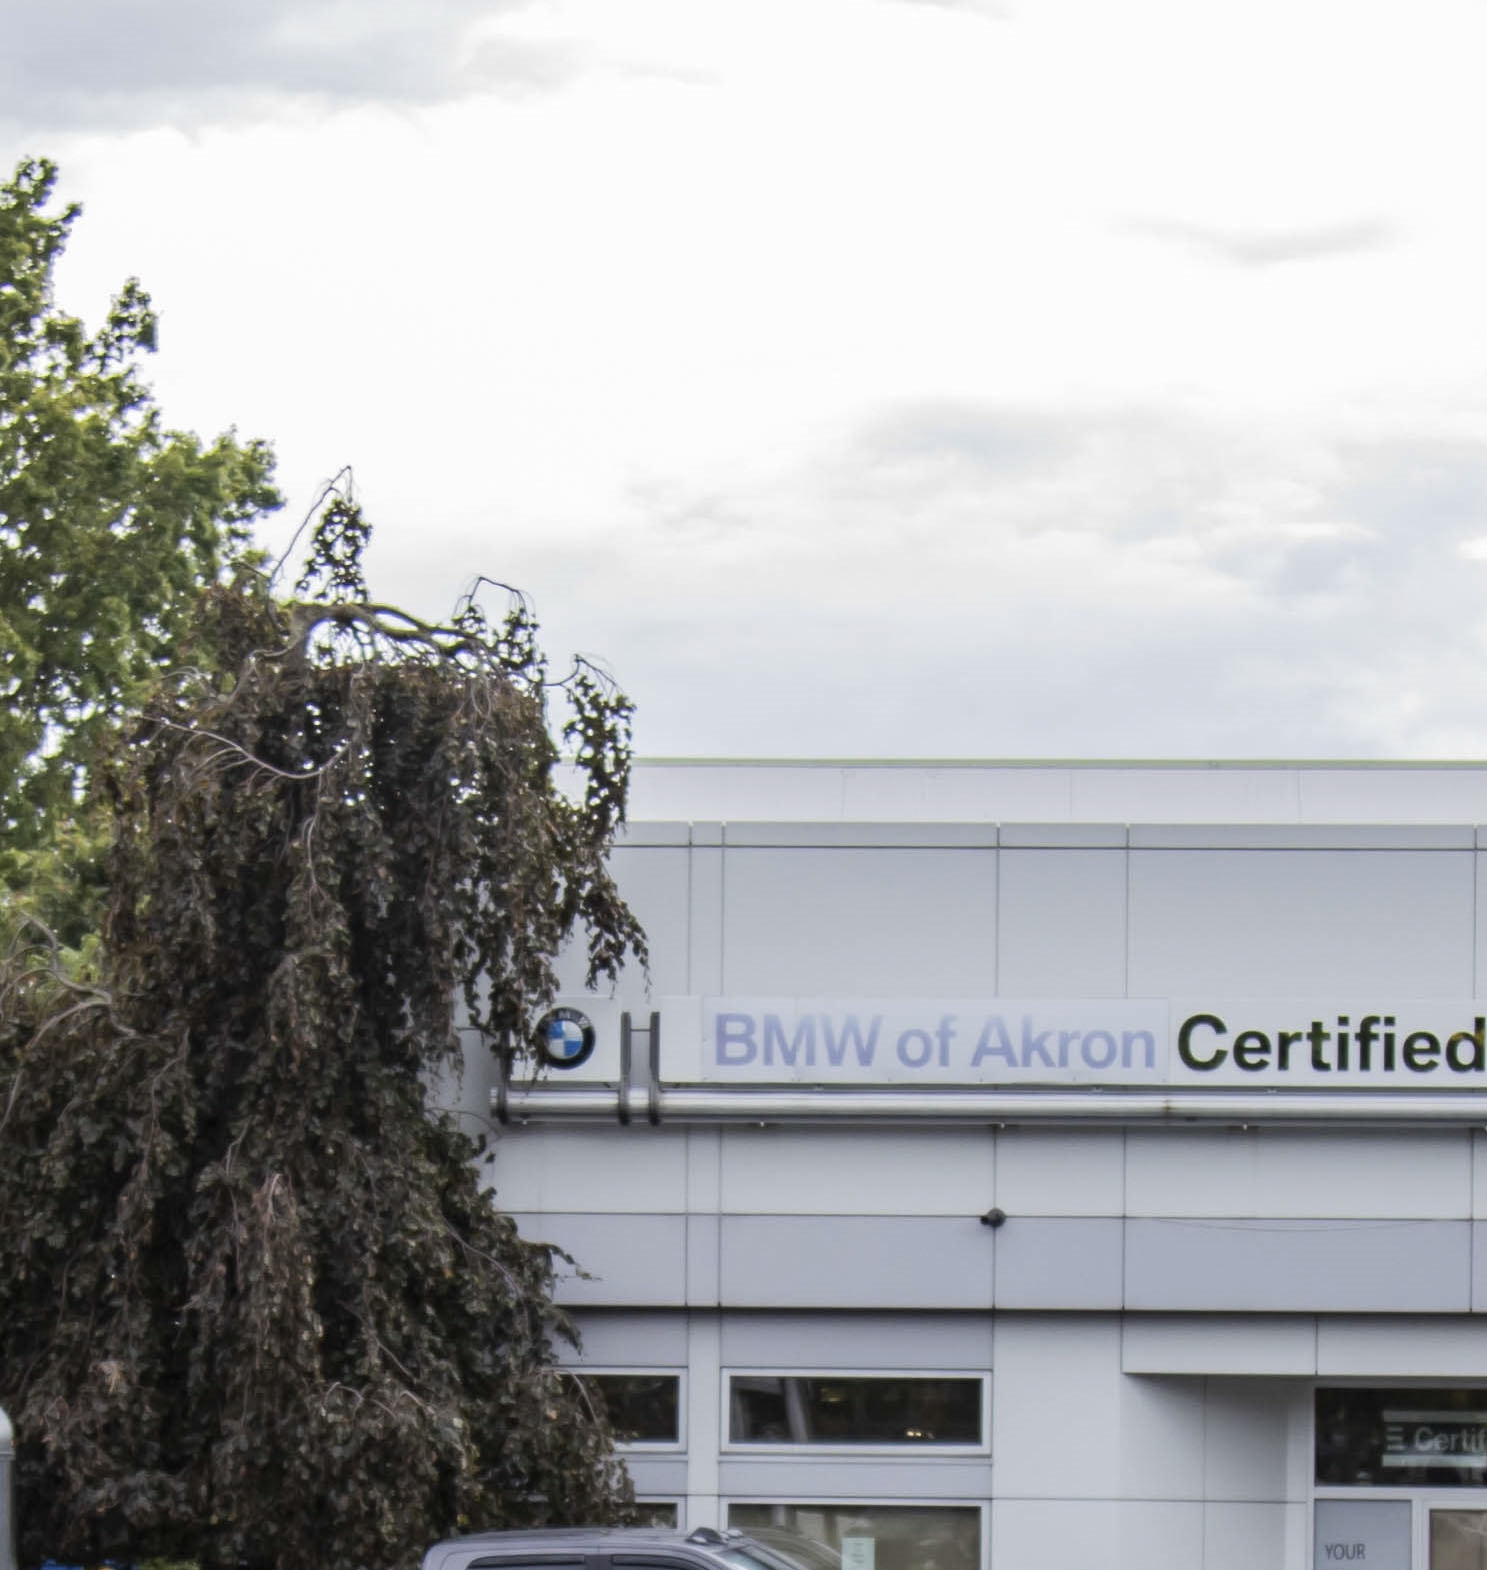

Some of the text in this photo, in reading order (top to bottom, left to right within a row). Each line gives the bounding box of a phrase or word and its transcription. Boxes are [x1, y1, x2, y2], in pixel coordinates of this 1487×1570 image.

[714, 1012, 880, 1067] BMW
[896, 1012, 957, 1068] of
[971, 1012, 1156, 1069] Akron
[1177, 1014, 1486, 1072] Certified
[1324, 1543, 1366, 1560] YOUR
